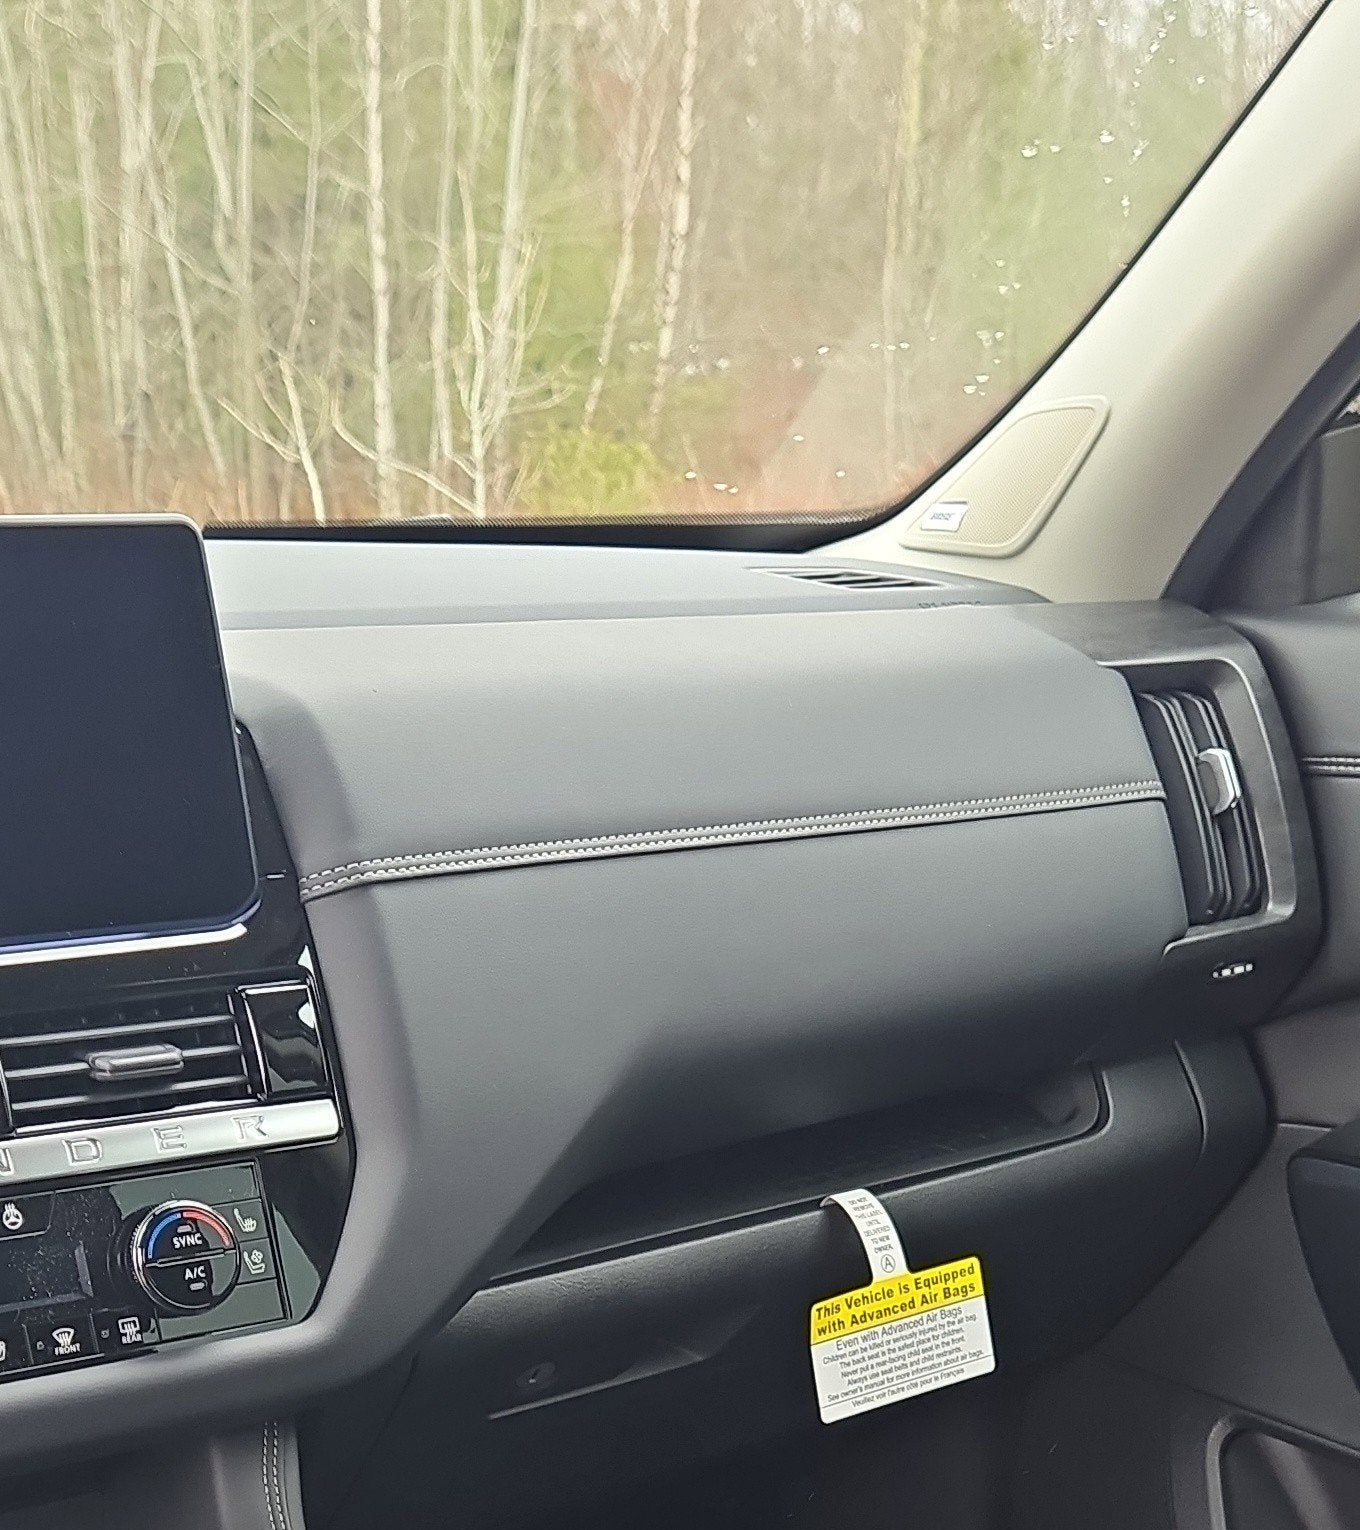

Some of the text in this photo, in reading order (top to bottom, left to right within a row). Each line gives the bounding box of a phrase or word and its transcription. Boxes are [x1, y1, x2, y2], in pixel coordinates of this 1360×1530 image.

[172, 1233, 203, 1249] SYNC
[184, 1265, 206, 1280] A/C
[815, 1262, 975, 1320] This Vehicle is Equipped
[817, 1282, 976, 1337] with Advanced Air Bags
[121, 1333, 142, 1345] REAR
[822, 1352, 848, 1365] Children
[848, 1348, 859, 1358] can
[859, 1346, 868, 1354] be
[868, 1340, 885, 1351] killed
[884, 1338, 892, 1347] or
[892, 1331, 918, 1344] seriously
[918, 1324, 938, 1337] injured
[938, 1323, 946, 1331] by
[946, 1320, 956, 1328] the
[835, 1306, 963, 1351] Even with Advanced Air Bags
[54, 1343, 81, 1355] FRONT
[839, 1360, 852, 1369] The
[851, 1355, 867, 1366] back
[867, 1351, 880, 1361] seat
[886, 1347, 897, 1355] the
[897, 1340, 915, 1352] safest
[915, 1336, 931, 1348] place
[931, 1333, 940, 1342] for
[840, 1368, 859, 1379] Never
[859, 1364, 870, 1375] put
[875, 1353, 907, 1369] rear-facing
[907, 1348, 921, 1359] child
[921, 1344, 934, 1355] seat
[934, 1343, 941, 1351] in
[940, 1340, 951, 1349] the
[827, 1393, 840, 1403] See
[840, 1386, 863, 1398] owner's
[864, 1378, 886, 1391] manual
[886, 1376, 895, 1384] for
[895, 1371, 911, 1381] more
[911, 1361, 943, 1376] information
[943, 1355, 960, 1367] about
[960, 1353, 968, 1362] air
[847, 1375, 869, 1387] Always
[868, 1371, 880, 1380] use
[880, 1366, 894, 1377] seat
[893, 1362, 909, 1372] belts
[909, 1357, 921, 1368] and
[921, 1353, 935, 1364] child
